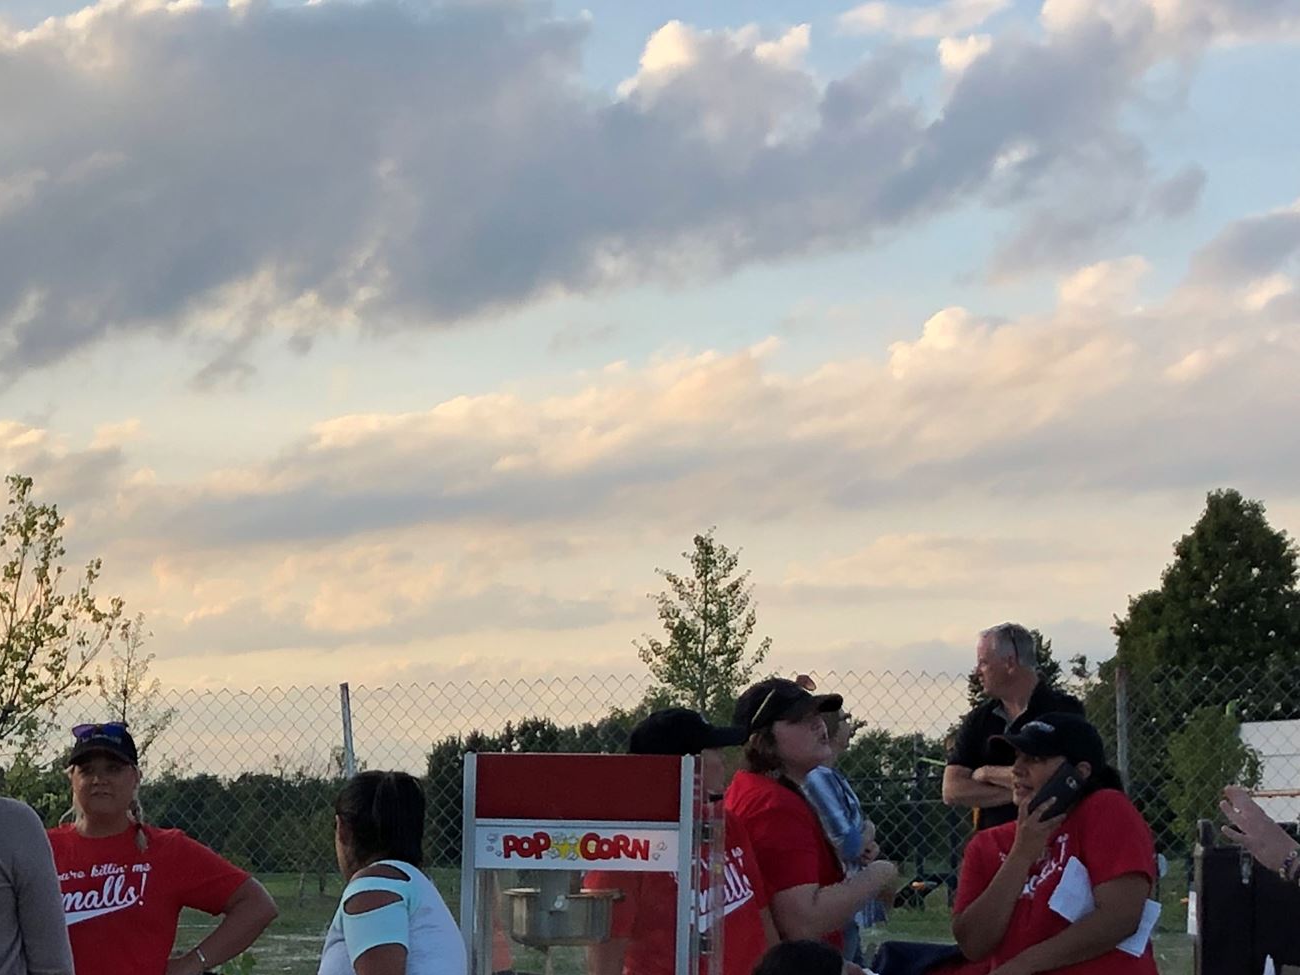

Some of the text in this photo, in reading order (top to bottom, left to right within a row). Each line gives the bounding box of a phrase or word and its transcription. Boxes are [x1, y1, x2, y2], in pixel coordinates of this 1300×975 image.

[502, 832, 650, 861] POP CORN
[60, 872, 147, 911] malls!
